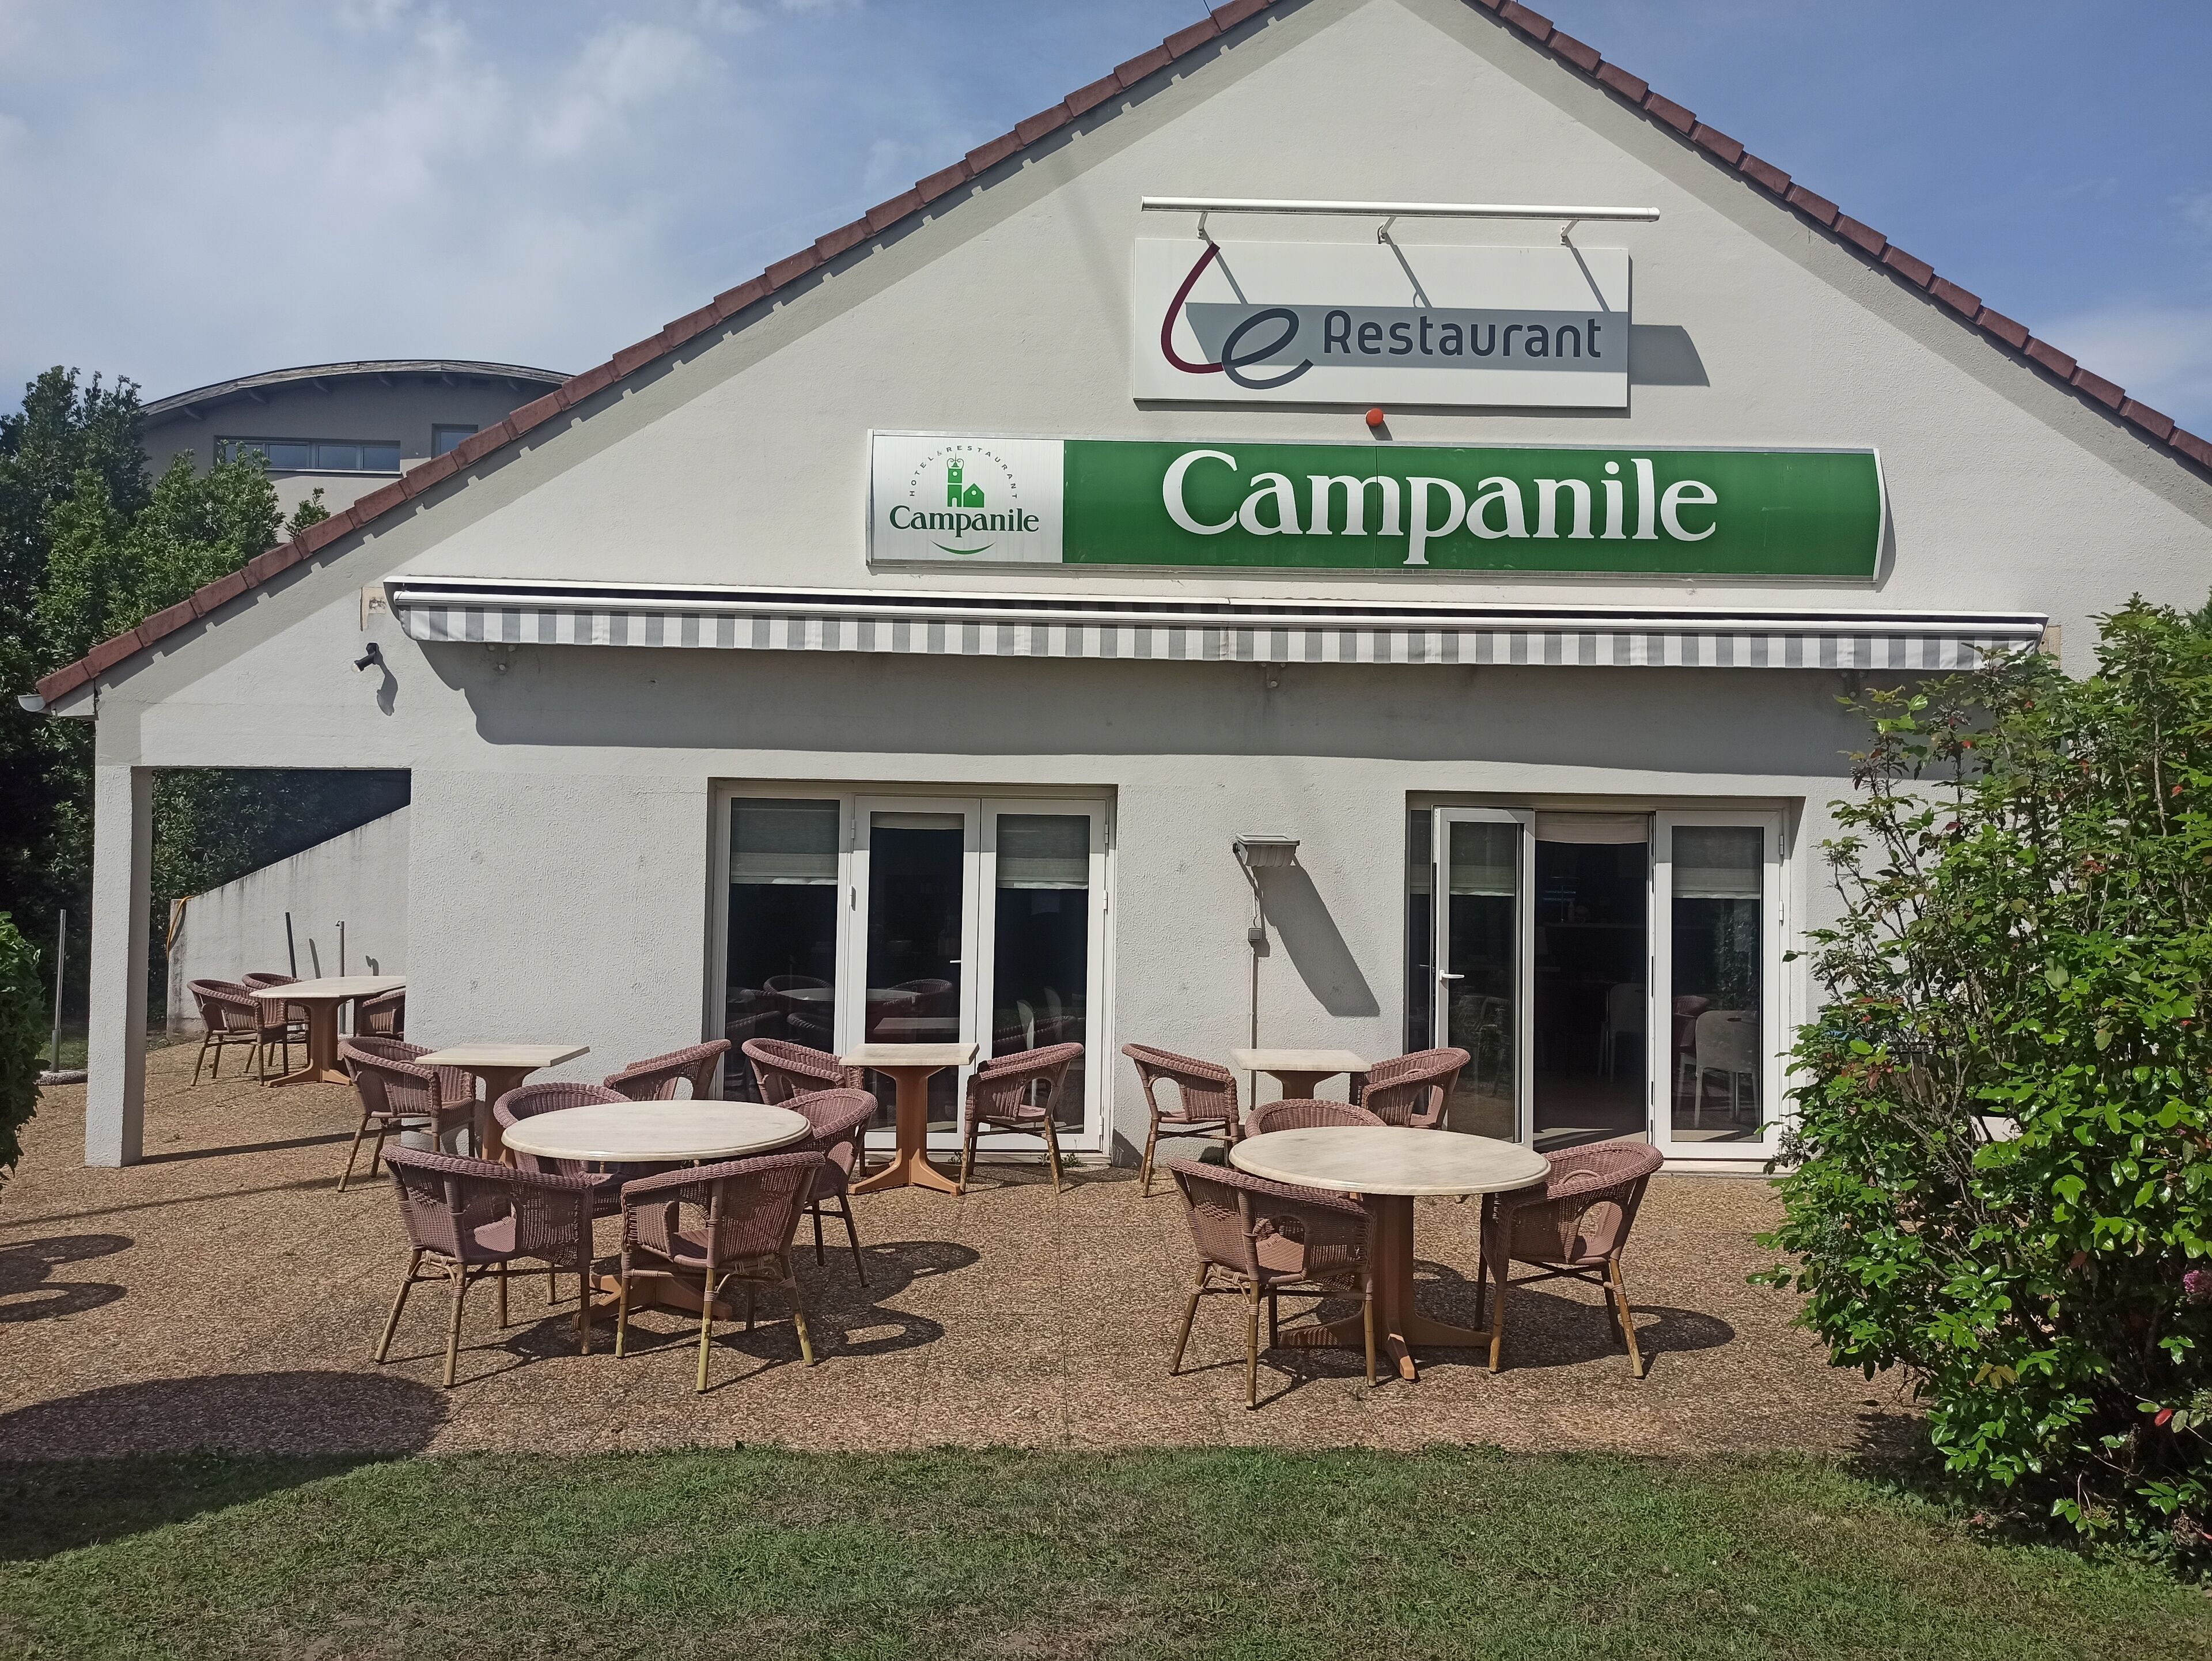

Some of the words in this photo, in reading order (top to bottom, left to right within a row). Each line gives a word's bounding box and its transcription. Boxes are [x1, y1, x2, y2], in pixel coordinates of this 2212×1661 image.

[1161, 243, 1313, 389] Le
[1323, 309, 1601, 359] Restaurant
[909, 456, 934, 497] HOTEL
[946, 445, 1017, 499] RESTAURANT
[1162, 449, 1718, 565] Campanile
[889, 505, 1039, 538] Campanile
